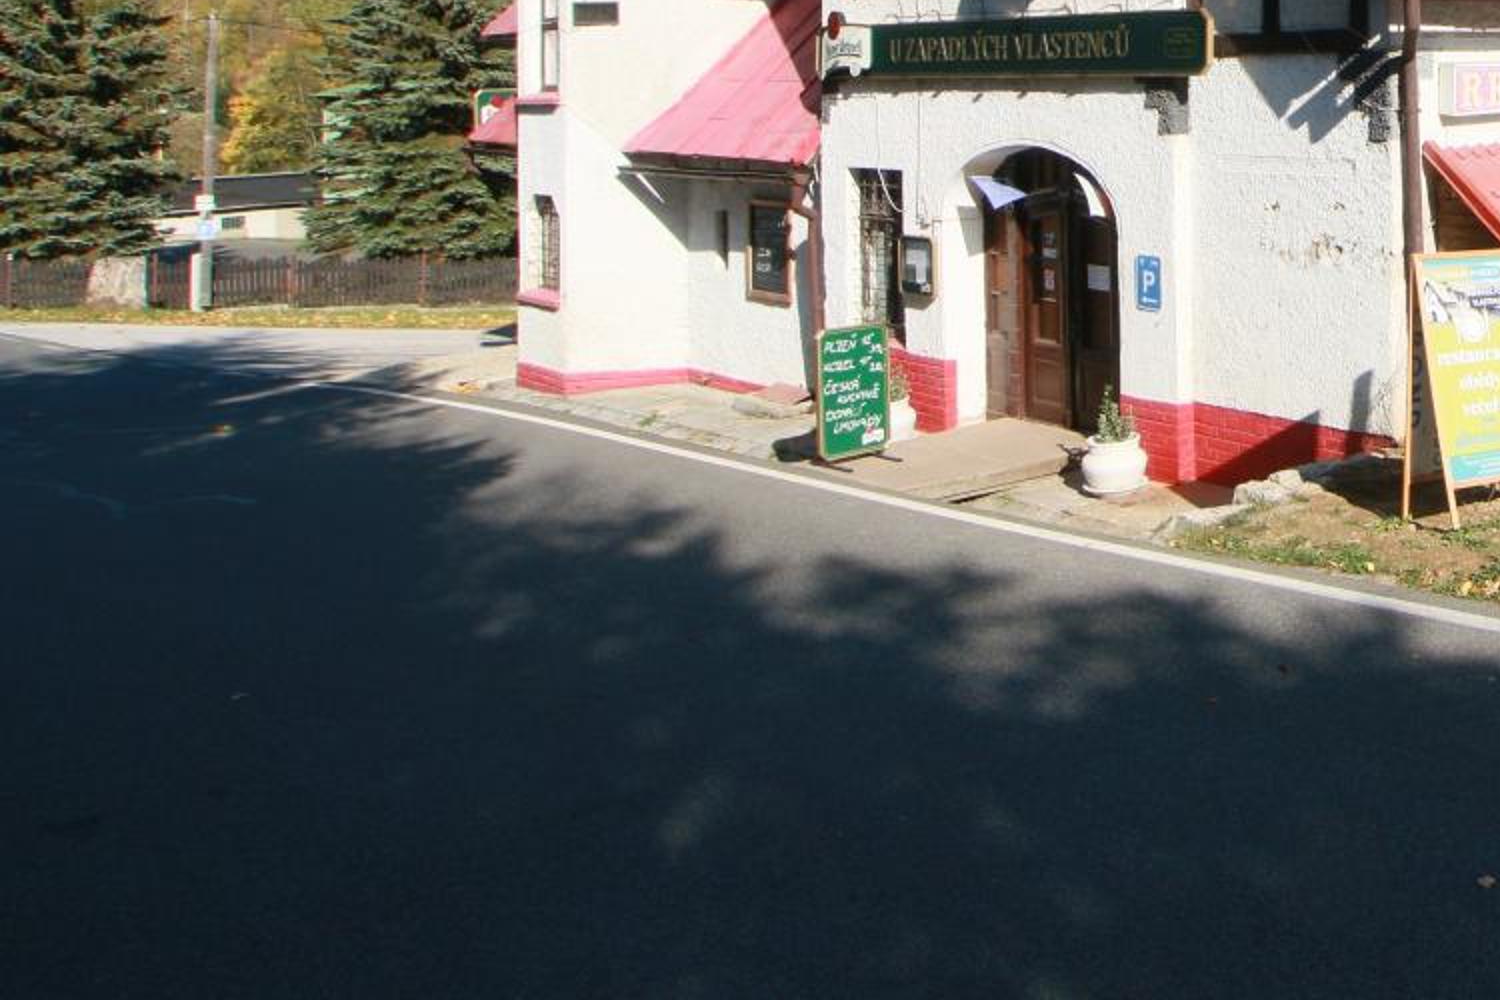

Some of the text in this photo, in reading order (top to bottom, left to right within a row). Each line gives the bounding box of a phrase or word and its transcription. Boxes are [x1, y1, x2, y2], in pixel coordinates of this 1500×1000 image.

[889, 39, 902, 63] U
[905, 30, 1008, 63] ZAPADLÝCH
[1013, 23, 1130, 61] VLASTENCŮ
[1143, 270, 1156, 293] P
